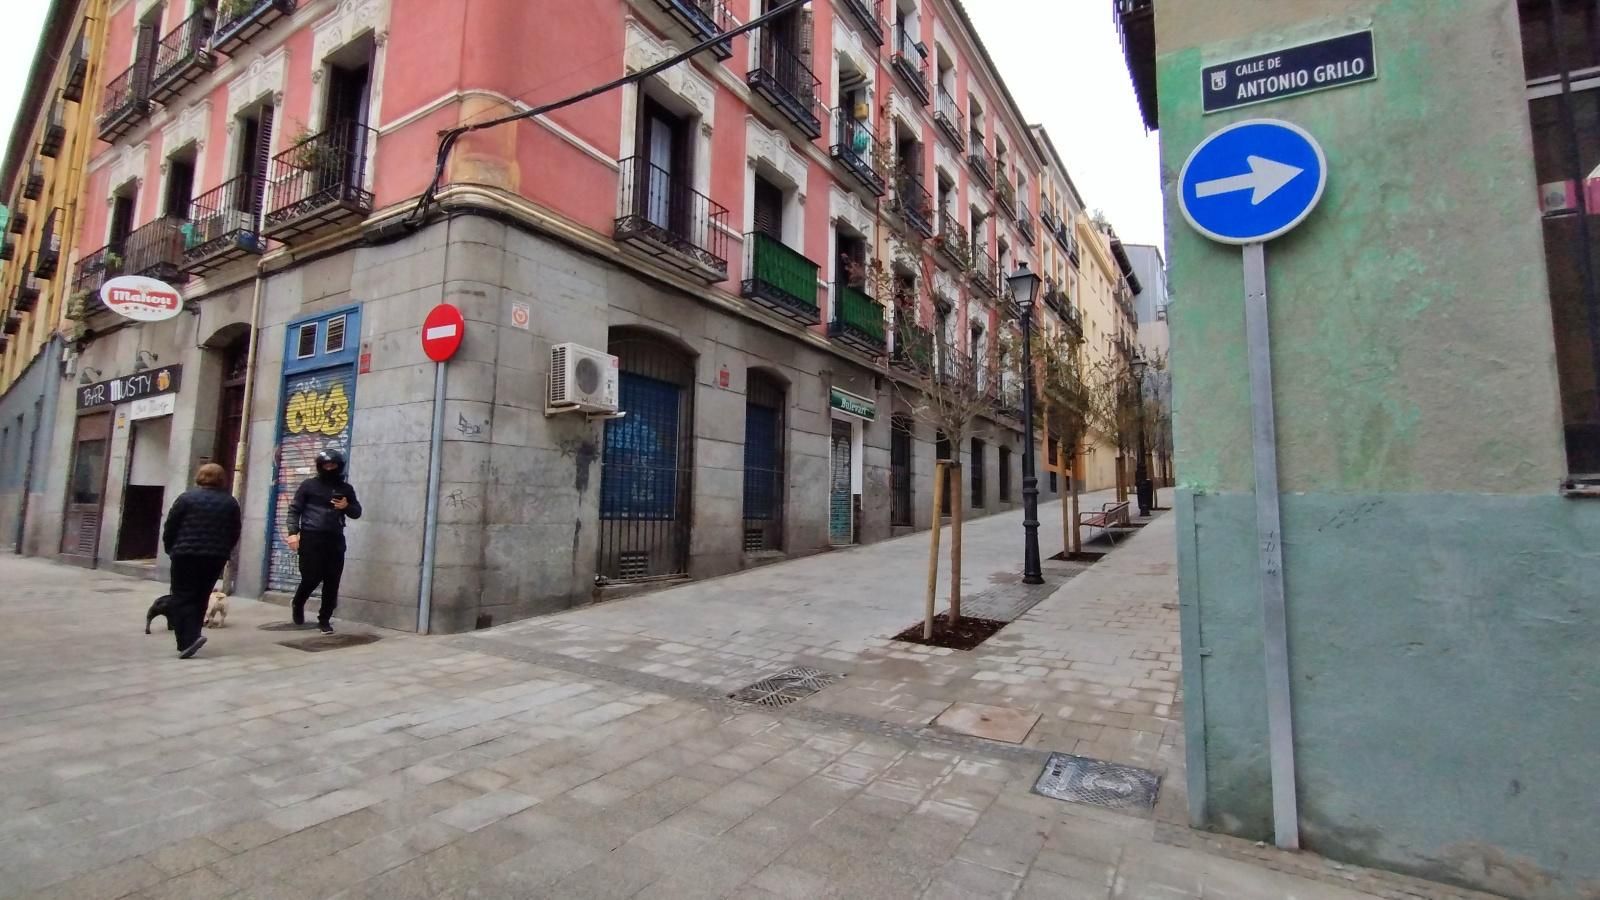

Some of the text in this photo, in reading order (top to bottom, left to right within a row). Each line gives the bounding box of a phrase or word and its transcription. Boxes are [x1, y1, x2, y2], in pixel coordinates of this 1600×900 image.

[1235, 57, 1281, 76] CALLE DE
[1237, 57, 1364, 99] ANTONIO GRILO
[113, 290, 172, 309] Mahou
[83, 374, 152, 406] BAR MUSTY
